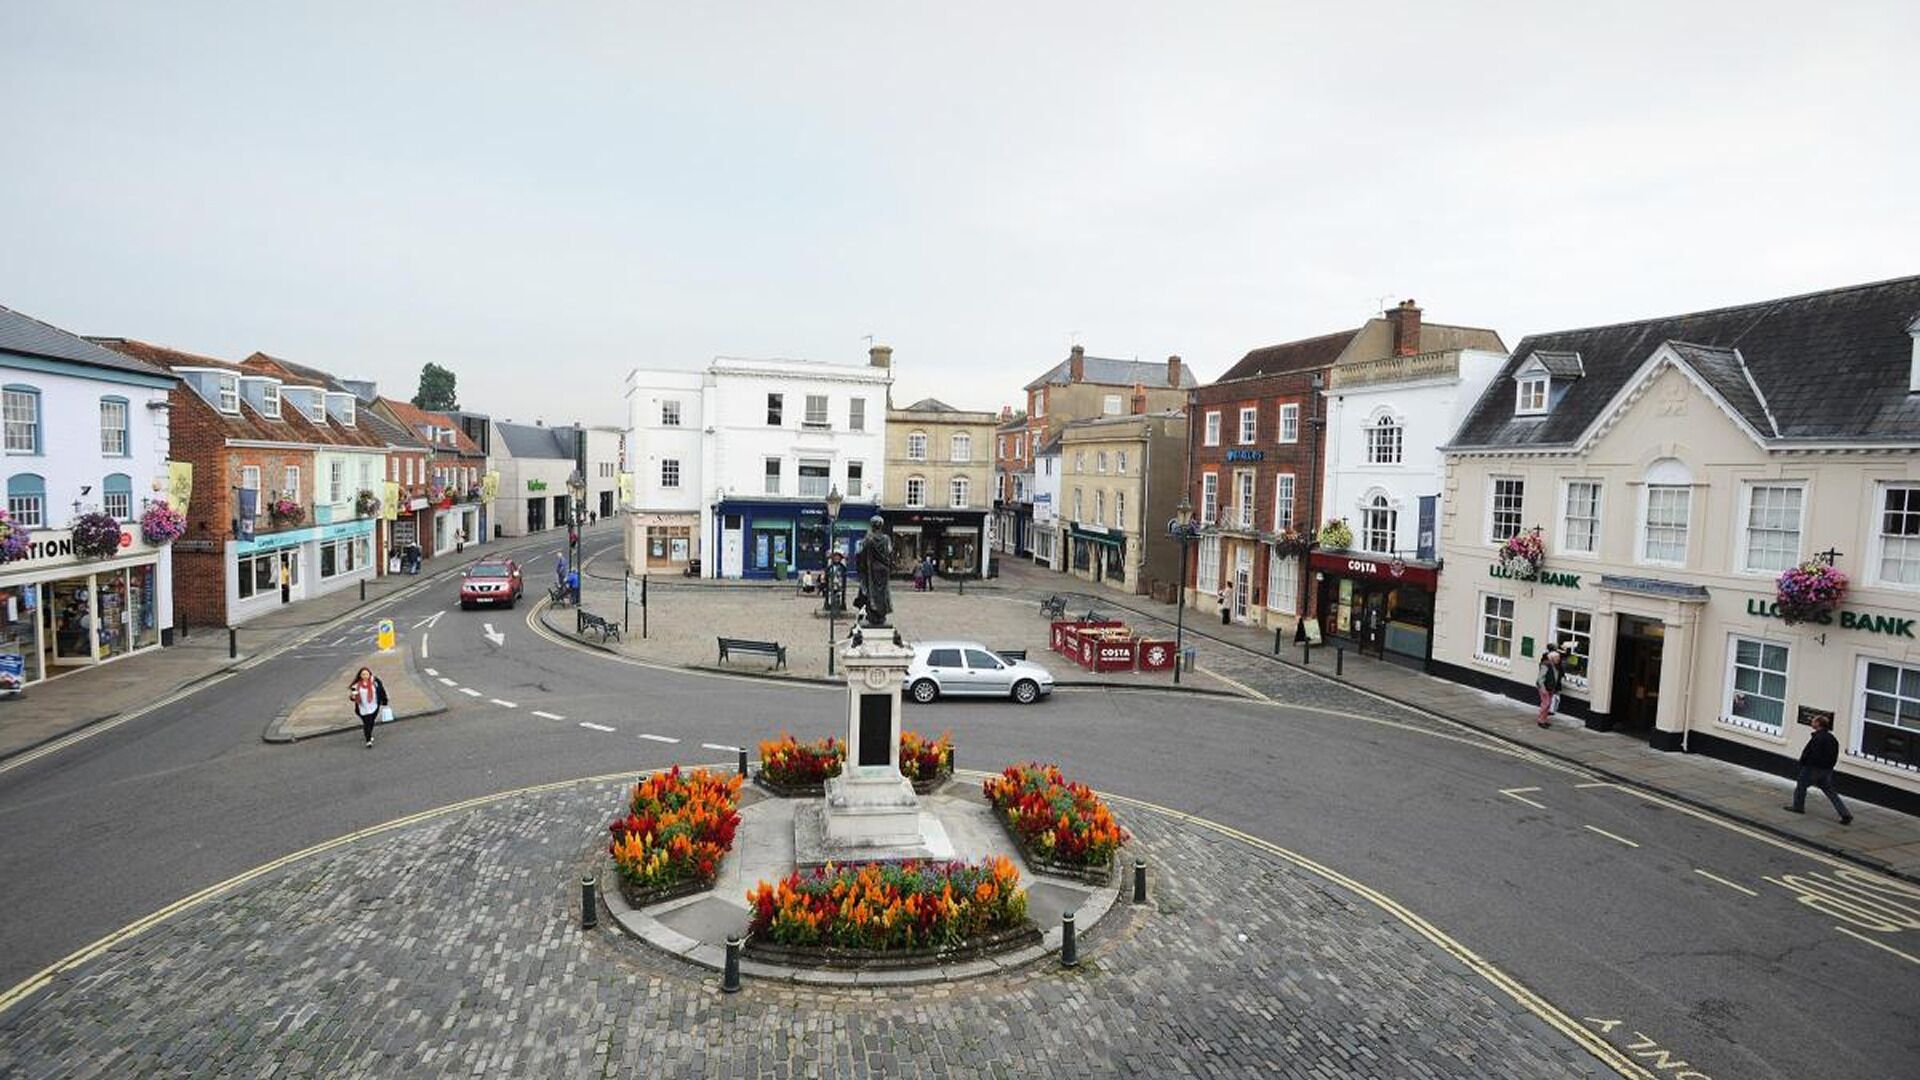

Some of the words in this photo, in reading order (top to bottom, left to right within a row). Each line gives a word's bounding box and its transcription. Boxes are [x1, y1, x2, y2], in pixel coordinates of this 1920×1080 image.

[1348, 561, 1377, 574] COSTA
[1489, 564, 1538, 582] LLOS
[1540, 571, 1582, 590] BANK
[1747, 598, 1833, 625] LLOS
[1840, 610, 1917, 639] BANK
[1101, 648, 1131, 657] COSTA
